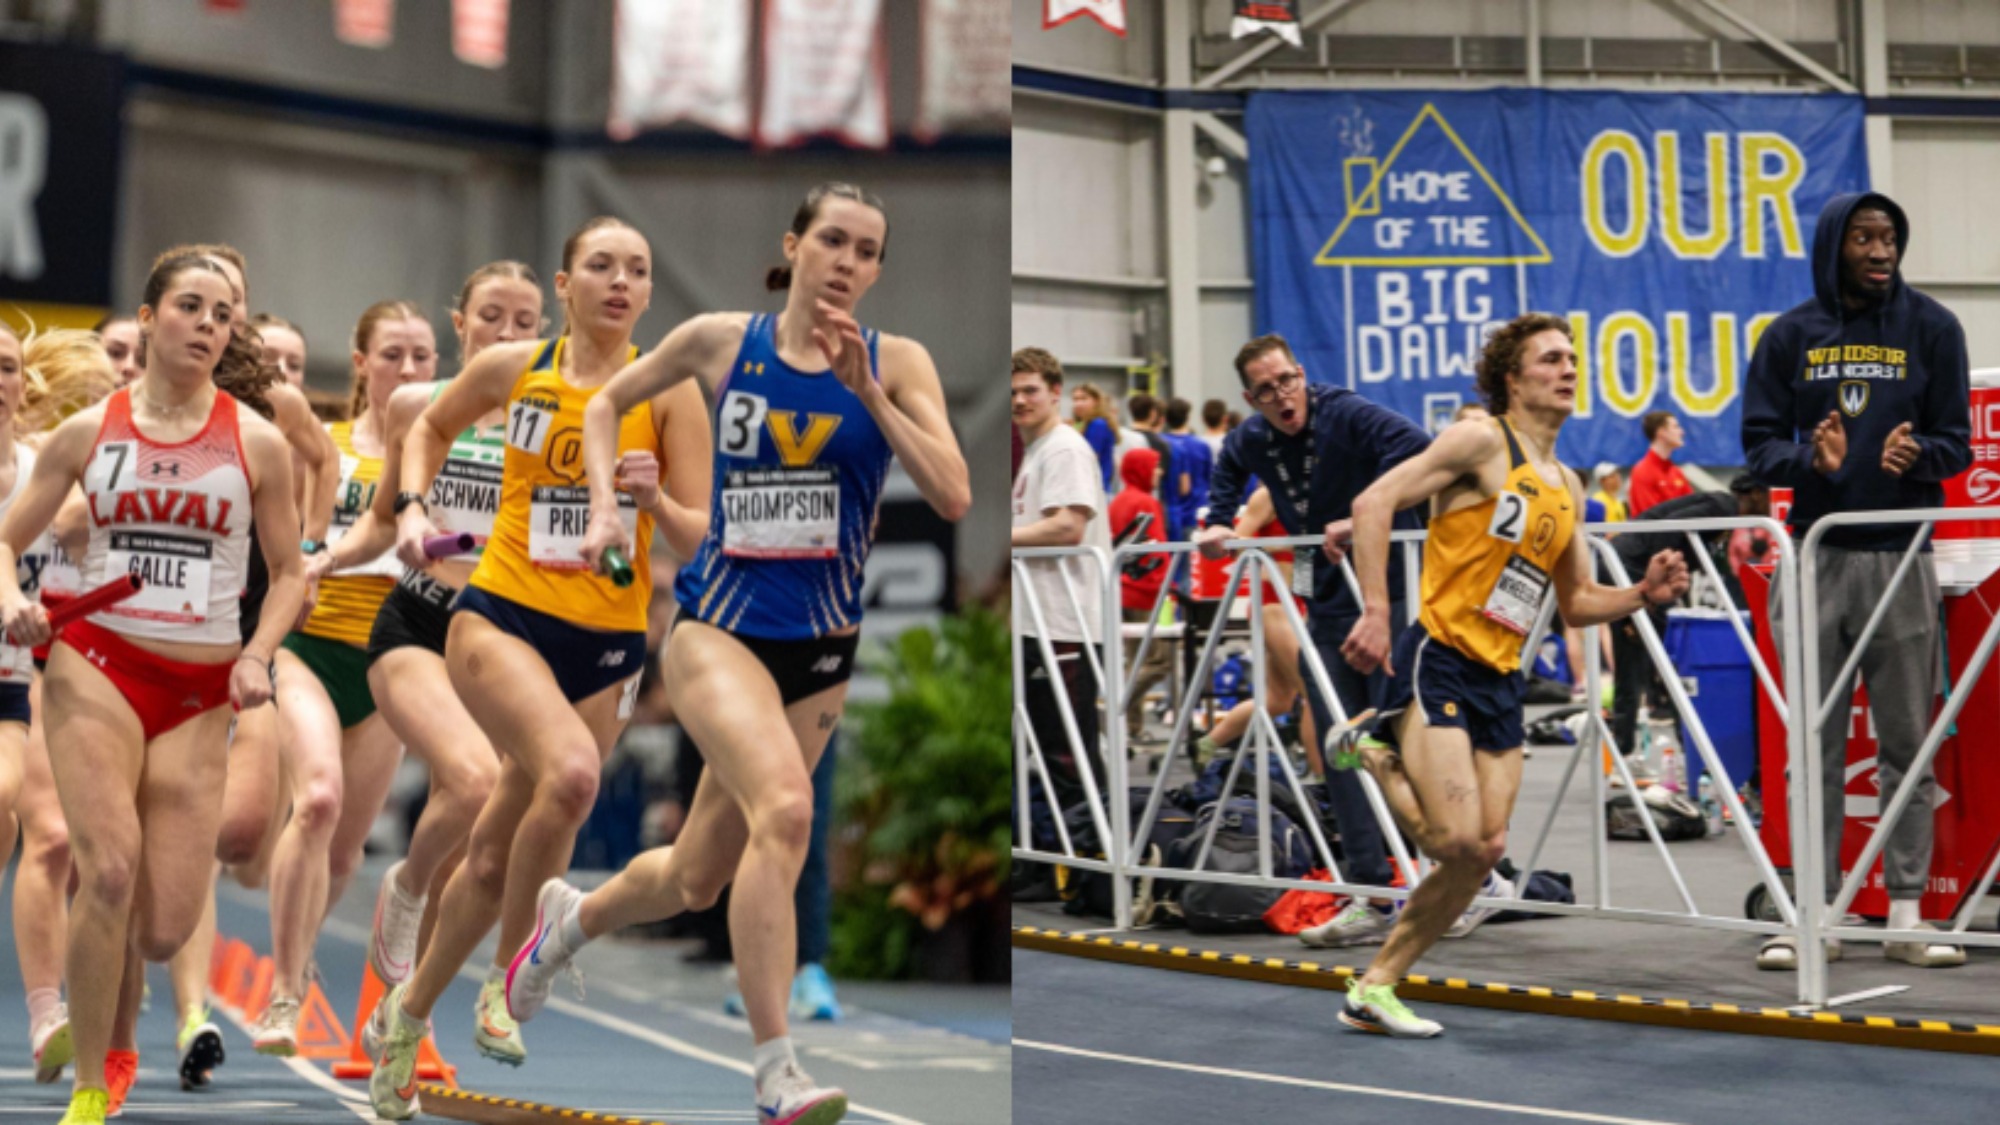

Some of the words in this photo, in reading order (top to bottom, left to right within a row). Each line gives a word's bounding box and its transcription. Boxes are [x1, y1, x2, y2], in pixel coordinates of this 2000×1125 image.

[1389, 171, 1471, 202] HOME
[1582, 129, 1806, 260] OUR
[1375, 217, 1415, 249] OF
[1429, 216, 1491, 248] THE
[1376, 267, 1492, 327] BIG
[1806, 345, 1907, 365] WINDSOR
[511, 406, 540, 450] 11
[726, 395, 756, 452] 3
[765, 410, 842, 466] V
[103, 443, 130, 492] 7
[88, 487, 234, 537] LAVAL
[431, 478, 503, 514] SCHWA
[725, 488, 837, 523] THOMPSON
[1496, 495, 1522, 539] 2
[128, 553, 189, 589] GALLE
